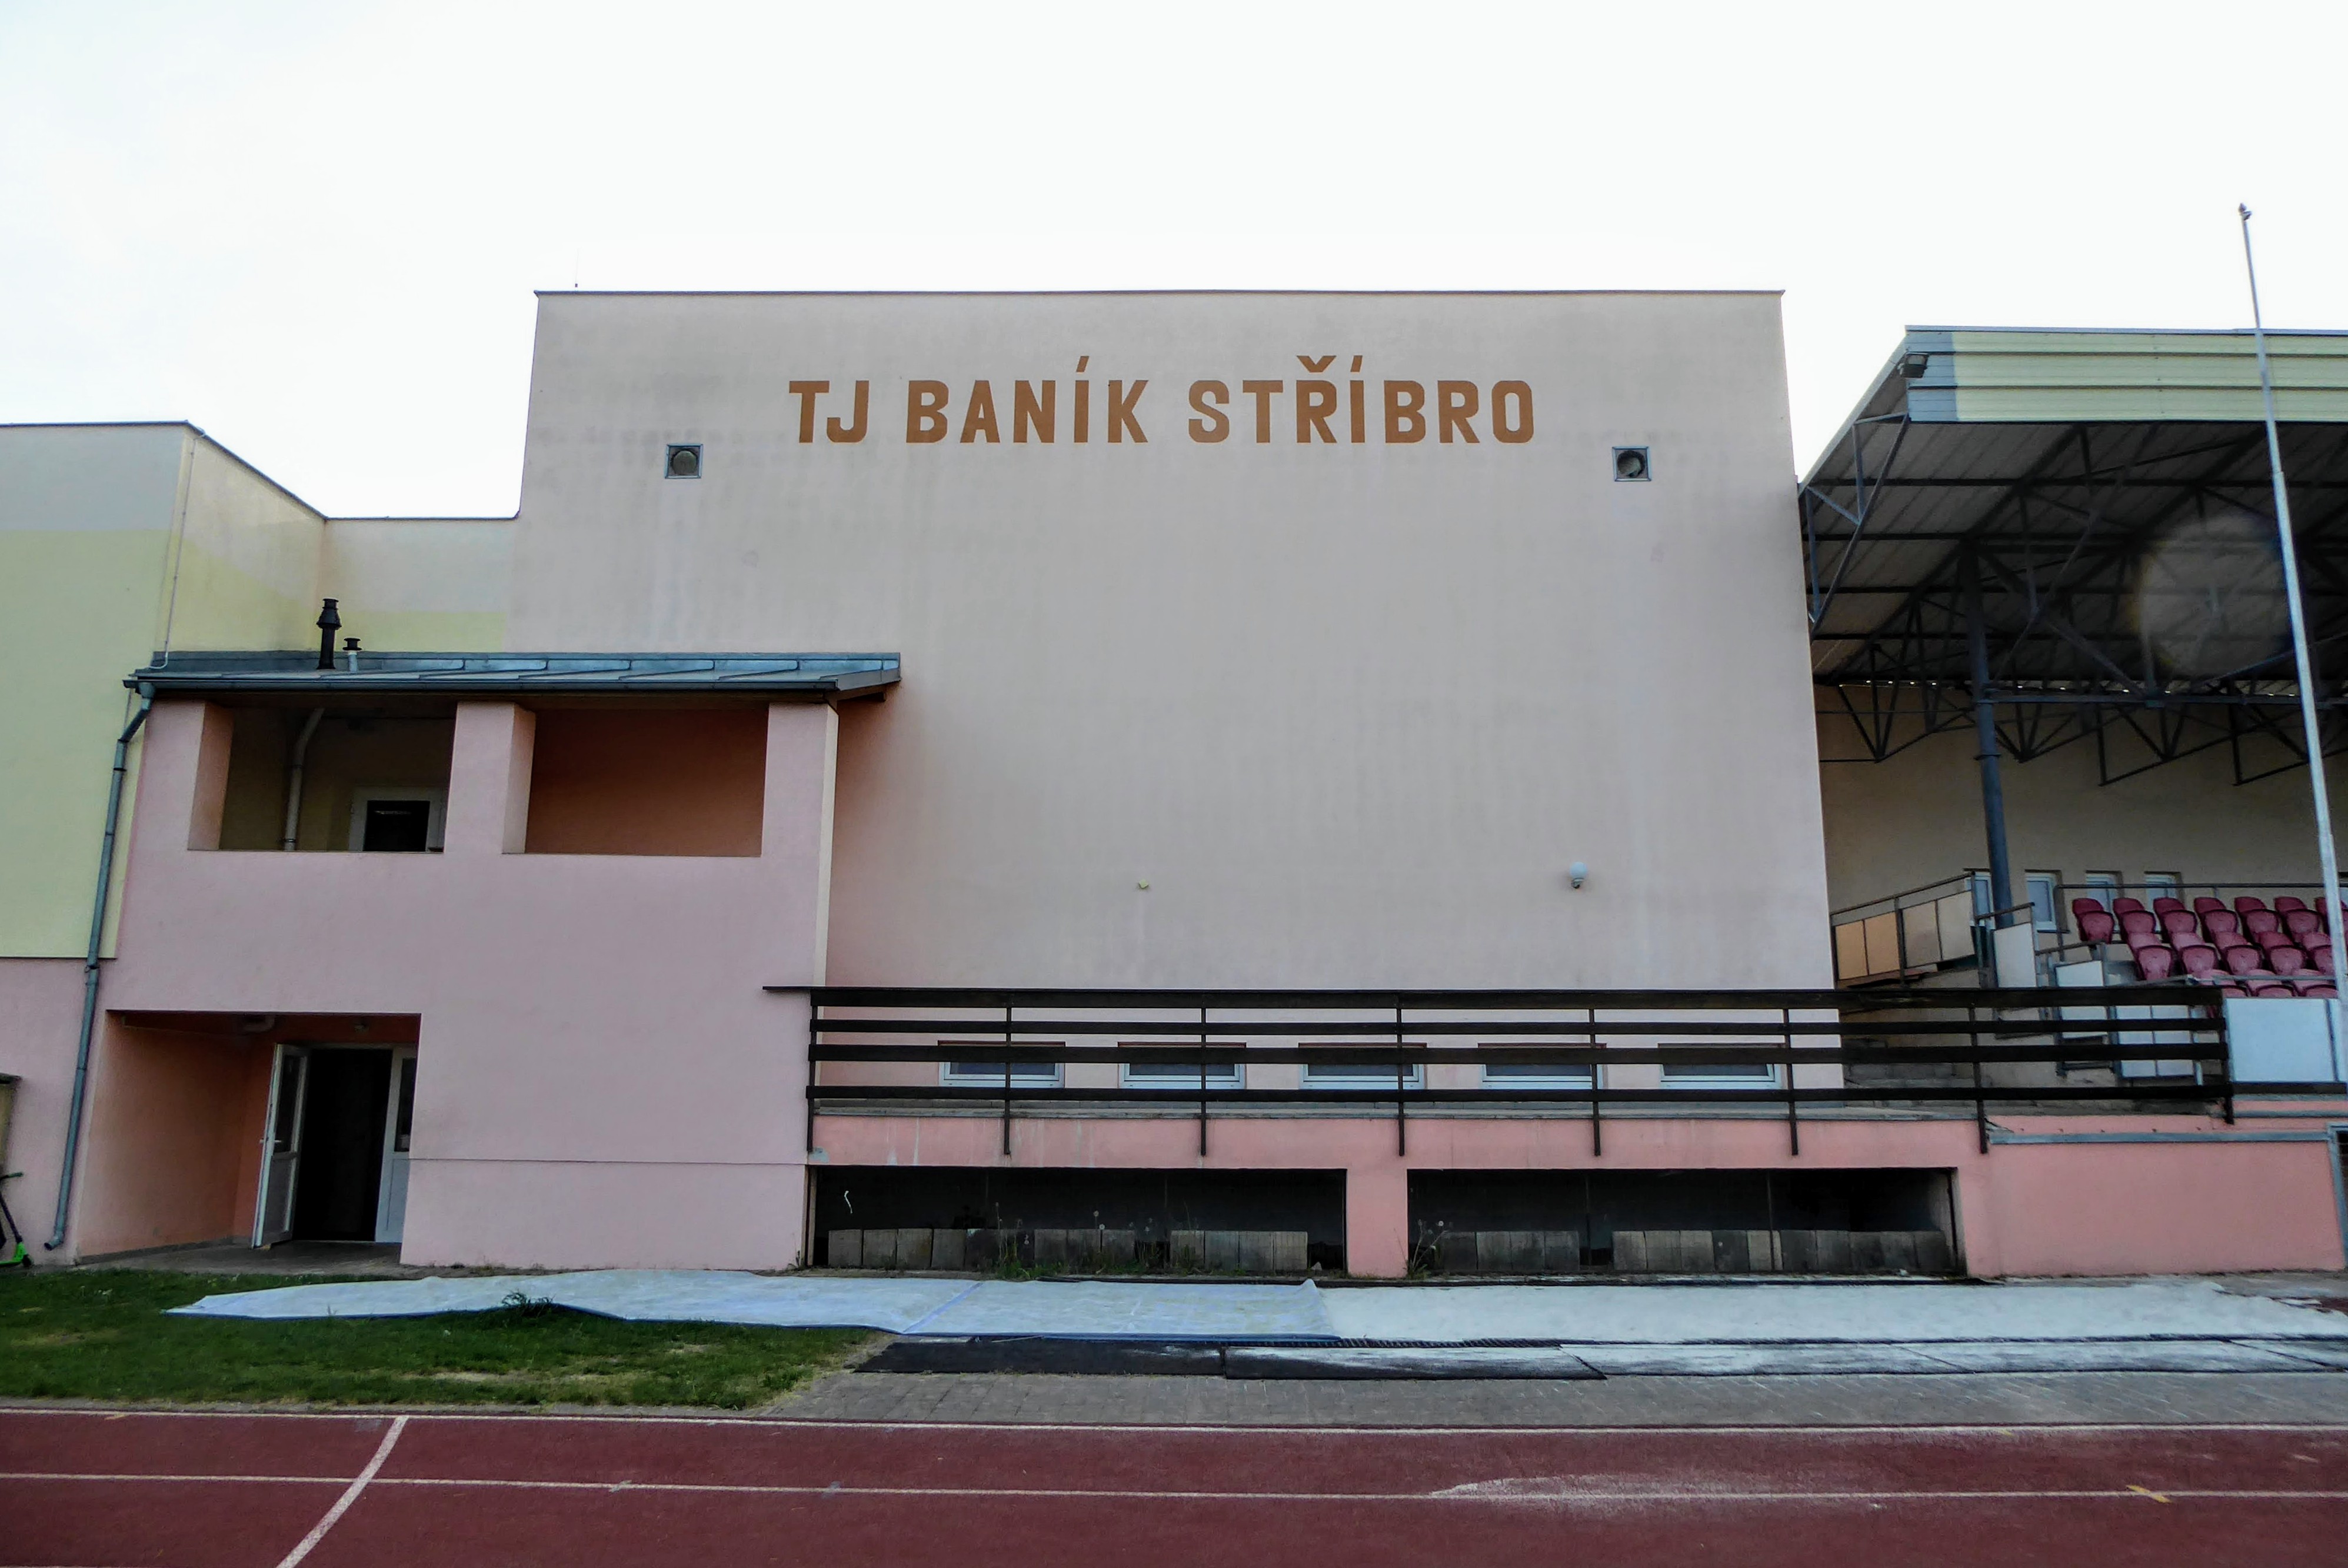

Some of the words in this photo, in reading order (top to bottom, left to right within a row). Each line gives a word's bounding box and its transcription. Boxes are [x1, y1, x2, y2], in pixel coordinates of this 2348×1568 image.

[789, 380, 870, 443] TJ
[906, 356, 1149, 443] BANÍK
[1188, 355, 1534, 443] STŘÍBRO
